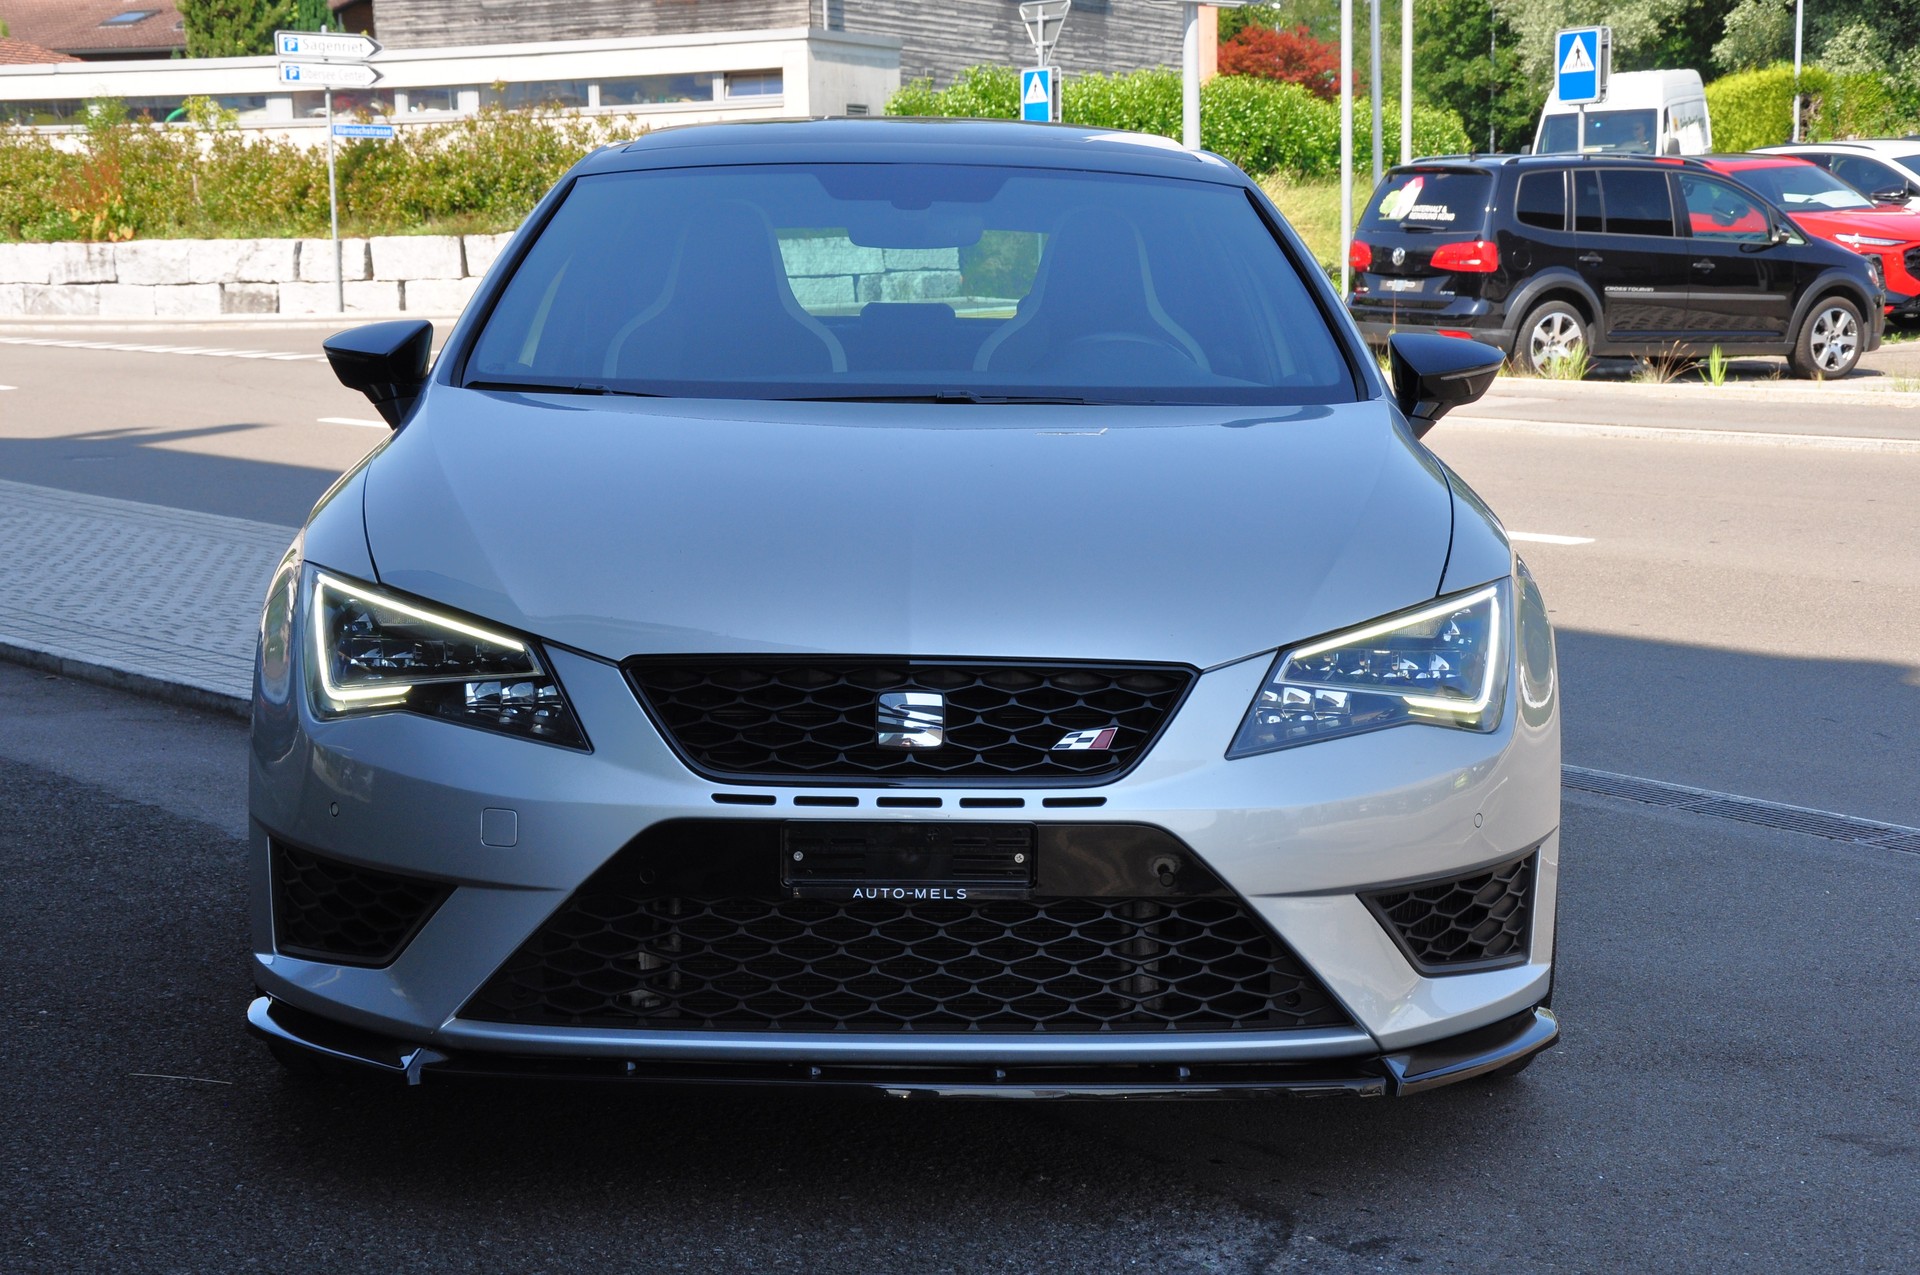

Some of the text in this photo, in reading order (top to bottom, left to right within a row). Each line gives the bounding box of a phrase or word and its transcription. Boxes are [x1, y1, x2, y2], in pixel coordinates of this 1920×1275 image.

[303, 38, 363, 54] Sagenriet
[302, 67, 335, 78] Obersee
[339, 68, 366, 80] Center
[852, 888, 967, 900] AUTO-MELS
